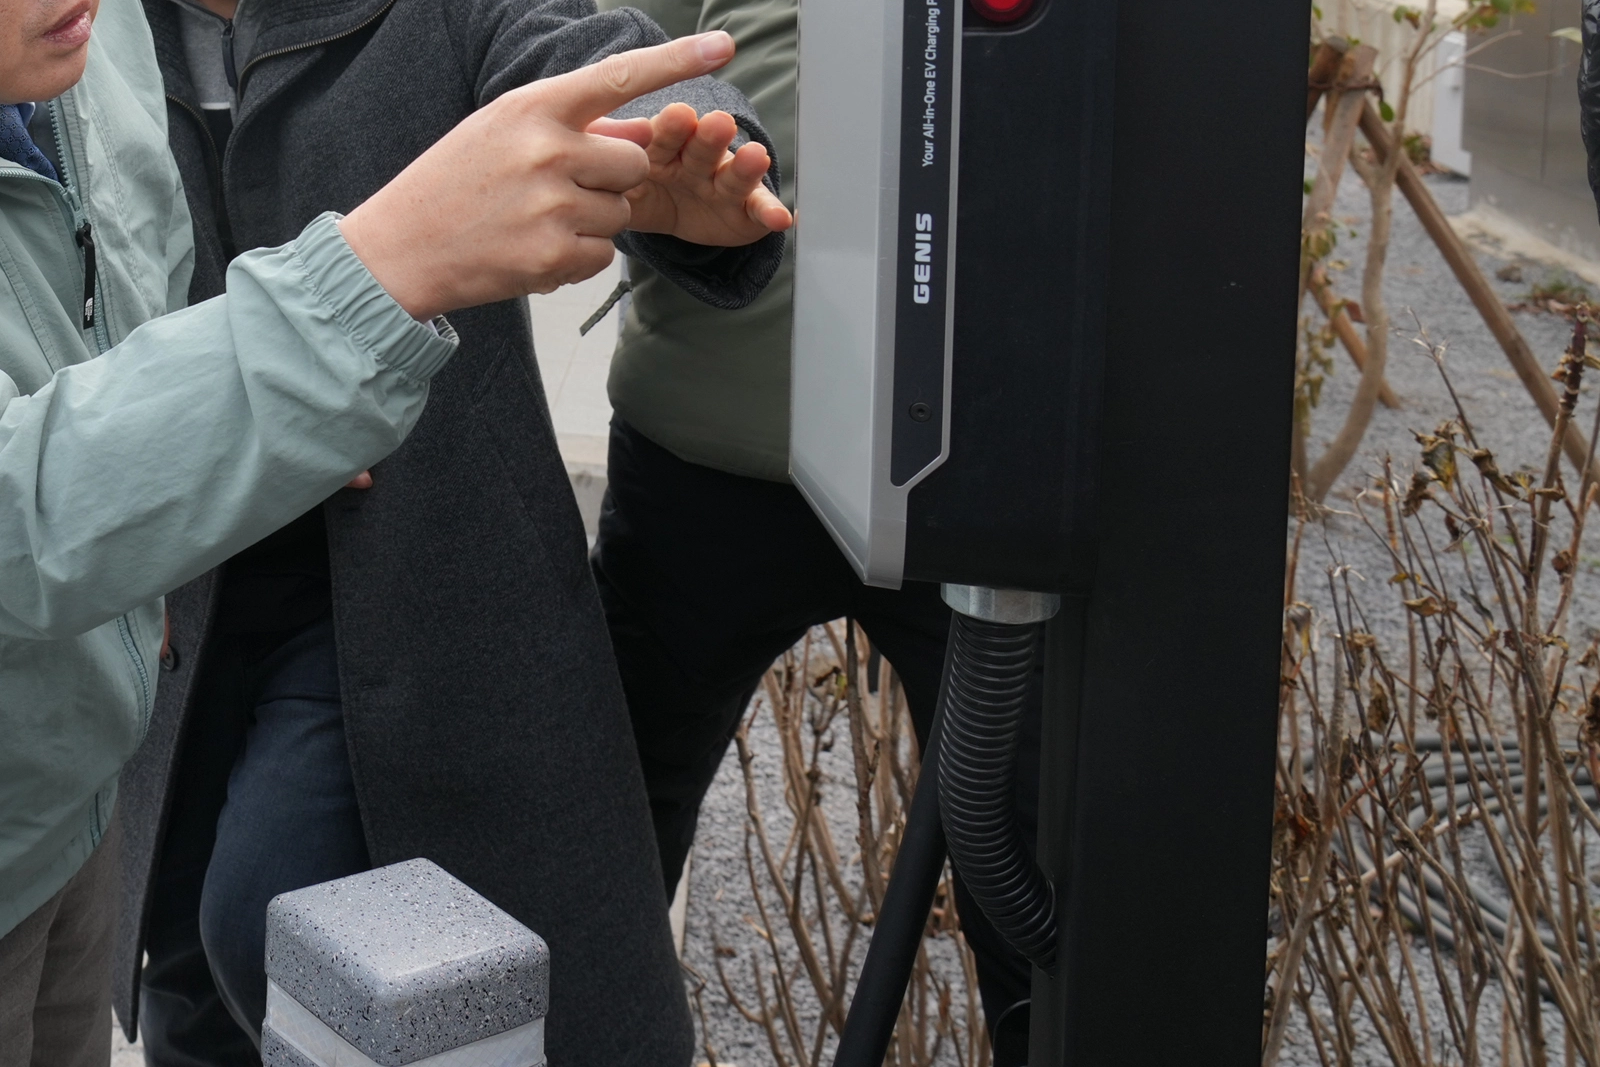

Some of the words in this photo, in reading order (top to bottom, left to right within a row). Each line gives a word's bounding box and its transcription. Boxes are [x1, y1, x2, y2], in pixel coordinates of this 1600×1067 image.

[925, 8, 940, 60] Charging
[924, 62, 937, 78] EV
[922, 80, 936, 138] All-in-One
[922, 140, 934, 167] Your
[913, 213, 932, 304] GENIS
